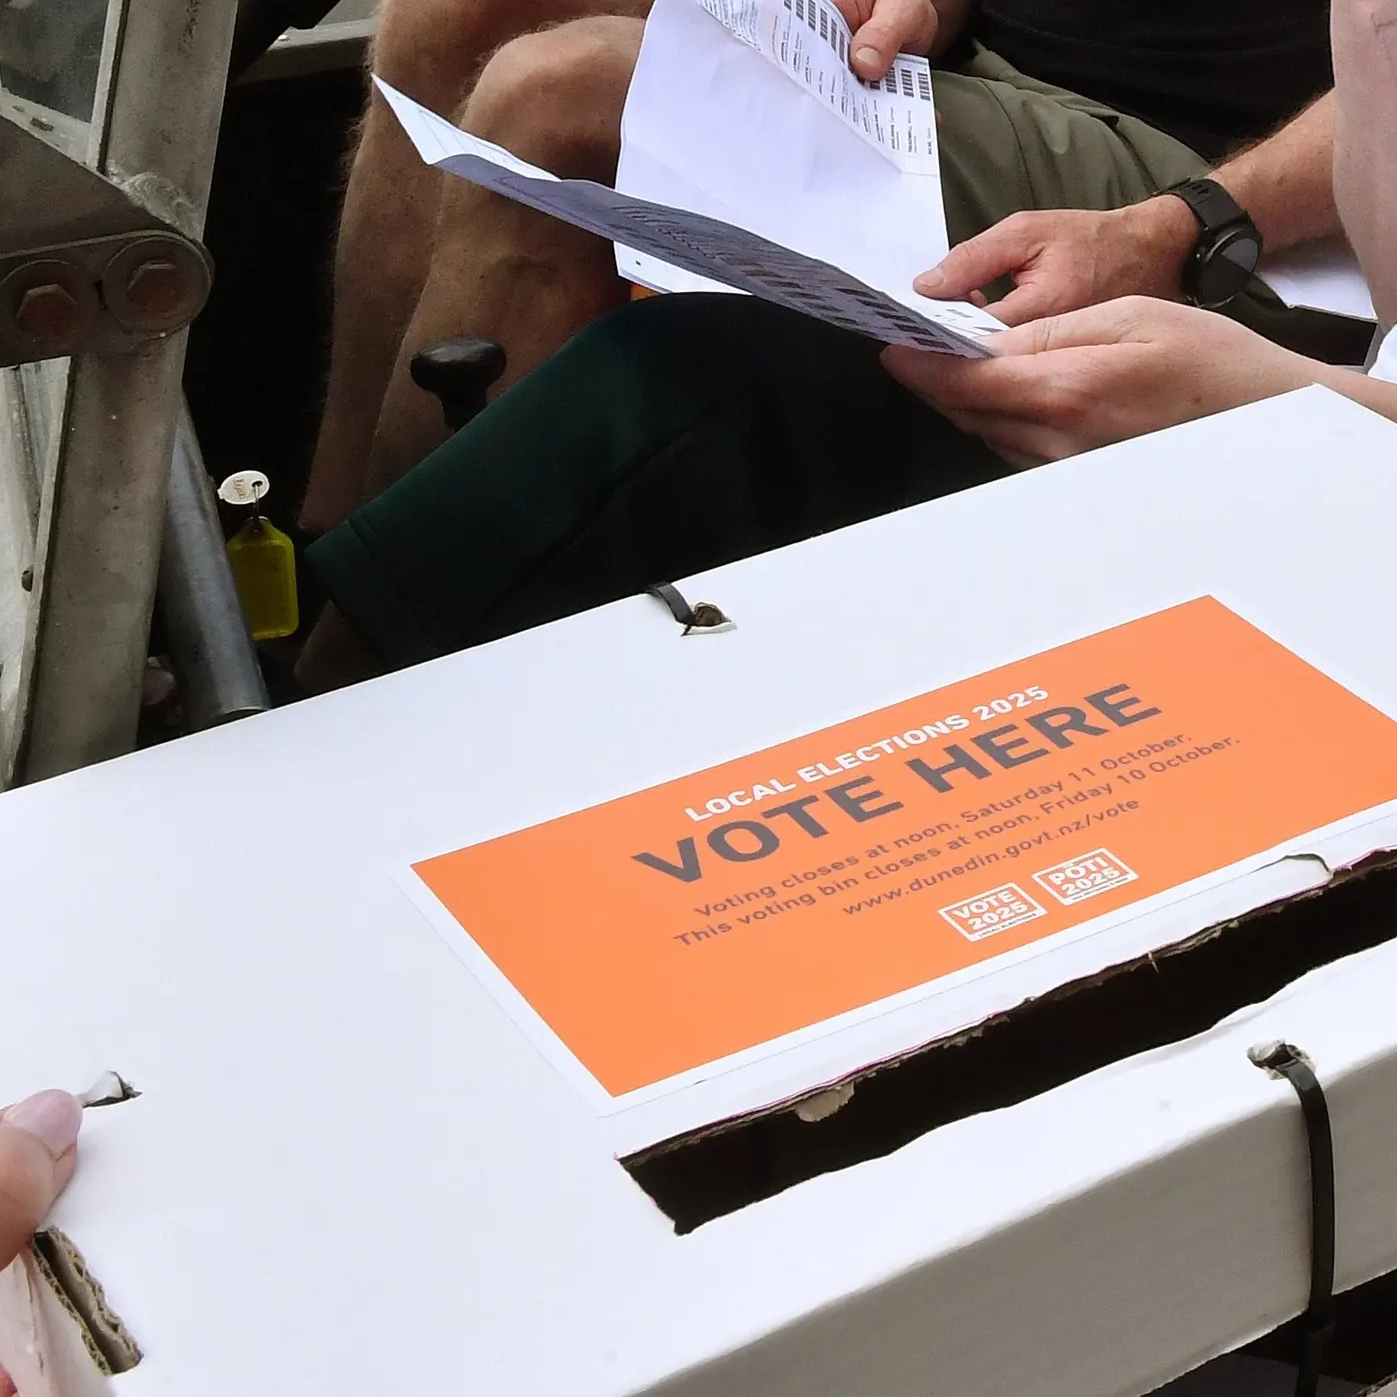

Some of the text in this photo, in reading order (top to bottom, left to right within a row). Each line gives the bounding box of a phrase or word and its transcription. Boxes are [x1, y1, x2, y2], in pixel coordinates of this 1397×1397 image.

[630, 683, 1162, 883] VOTE HERE
[685, 685, 1049, 822] LOCAL ELECTIONS 2025
[674, 922, 732, 946] This
[737, 892, 816, 925] voting
[817, 877, 858, 896] bin
[864, 847, 941, 880] closes
[947, 835, 971, 851] at
[1040, 781, 1113, 816] Friday
[1117, 768, 1147, 784] 10
[694, 884, 777, 918] Voting
[781, 855, 860, 889] closes
[868, 844, 889, 860] at
[961, 780, 1064, 824] Saturday
[1068, 767, 1096, 782] 11
[842, 799, 1140, 915] www.dunedin.govt.nz/vote
[952, 890, 1017, 920] VOTE
[1061, 866, 1121, 897] 2025
[968, 901, 1029, 931] 2025
